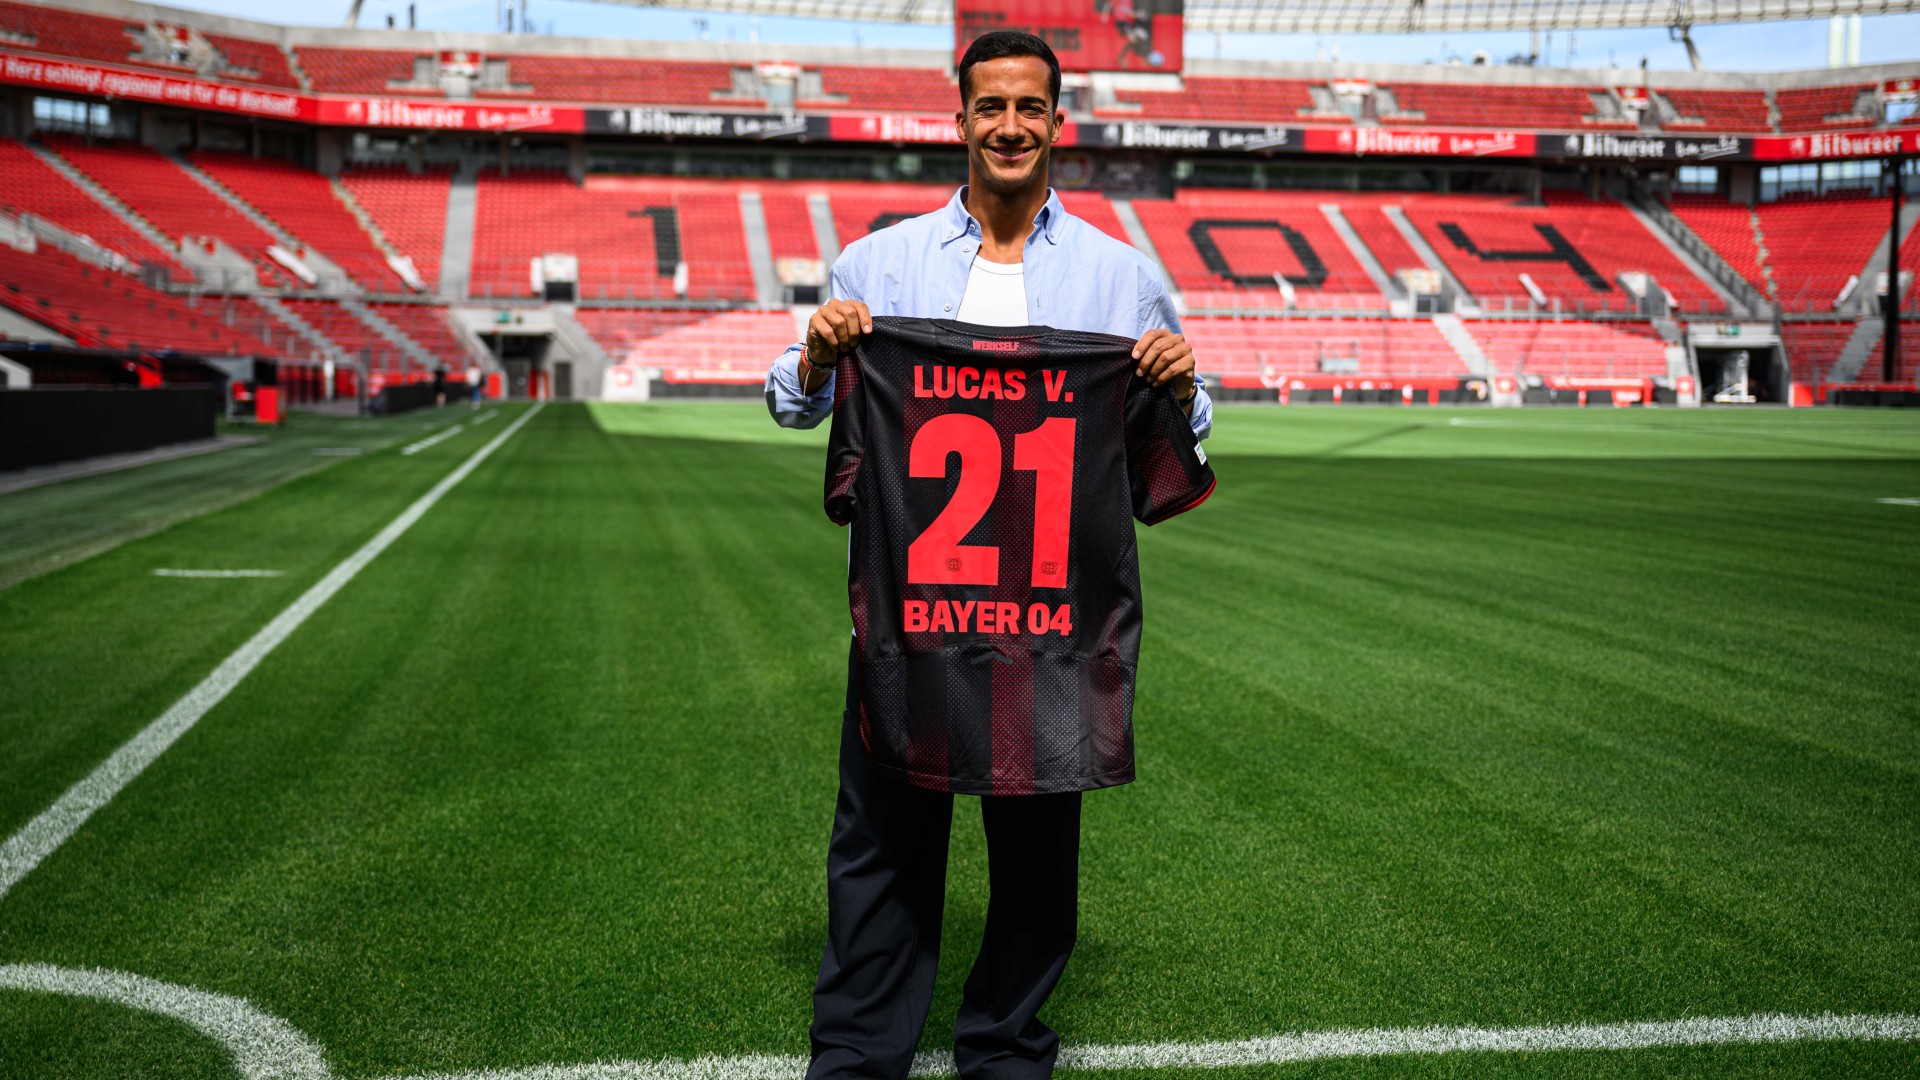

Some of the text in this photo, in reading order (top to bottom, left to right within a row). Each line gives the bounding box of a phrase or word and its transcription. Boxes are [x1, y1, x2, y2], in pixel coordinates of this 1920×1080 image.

[367, 100, 466, 128] Bitburger
[629, 108, 725, 135] Bitburger
[1121, 121, 1211, 148] Bitburger
[1355, 127, 1441, 153] Bitburger
[1582, 133, 1665, 158] Bitburger
[1810, 133, 1903, 158] Bitburger
[972, 340, 1020, 352] WERKSELF
[914, 365, 1074, 403] LUCAS V.
[908, 413, 1077, 589] 21
[904, 600, 1073, 637] BAYER 04
